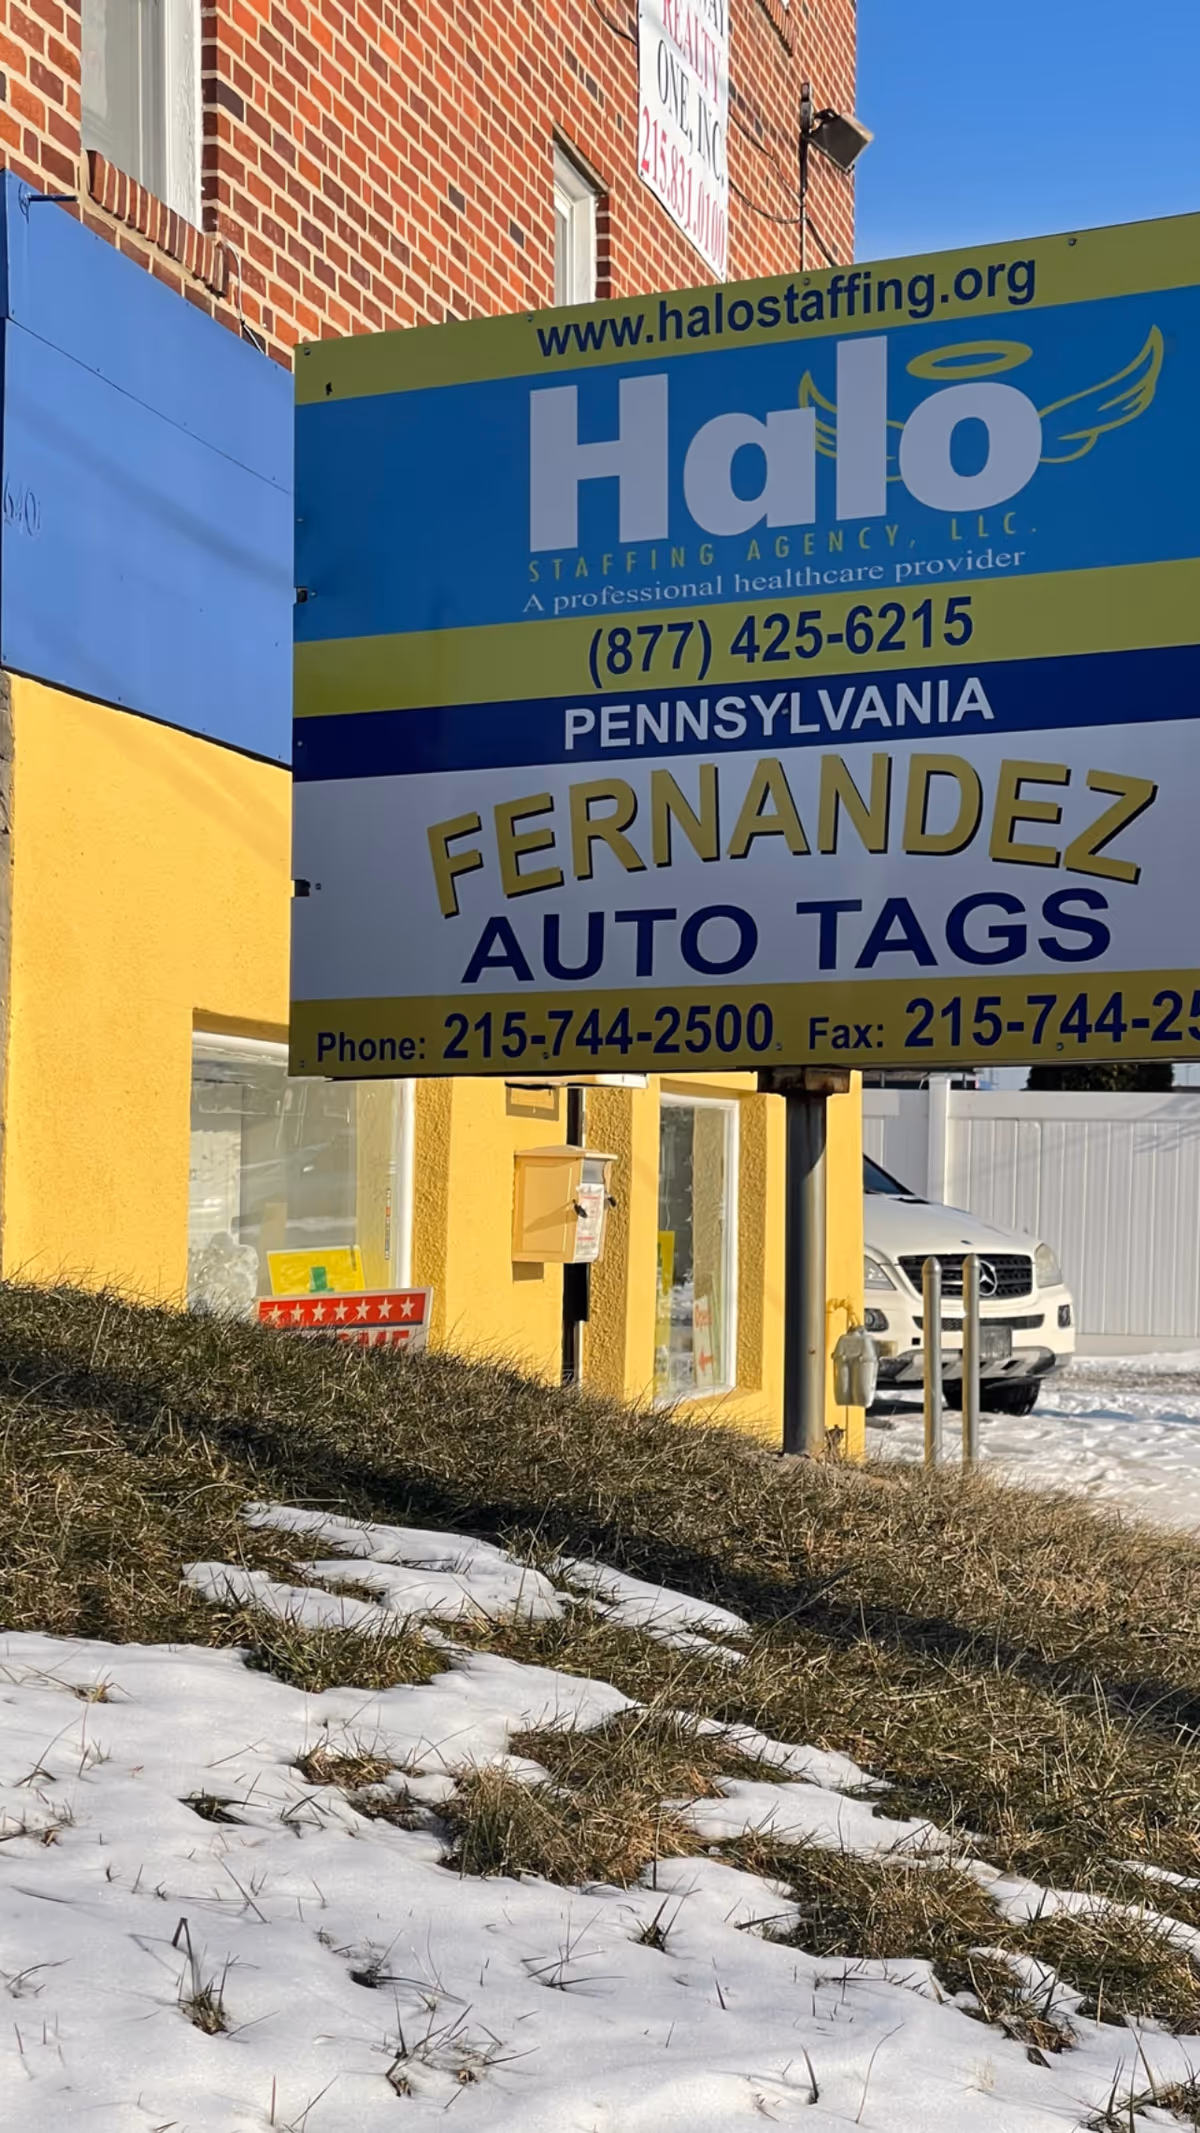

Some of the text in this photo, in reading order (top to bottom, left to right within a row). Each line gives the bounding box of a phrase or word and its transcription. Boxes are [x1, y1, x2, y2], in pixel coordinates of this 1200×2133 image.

[641, 105, 726, 270] 215.831.0100
[537, 258, 1036, 357] www.halostaffing.org
[530, 335, 1043, 553] Halo
[522, 548, 1026, 614] A professional healthcare provider
[528, 511, 1037, 583] STAFFING AGENCY, LLC.
[588, 596, 974, 689] (877) 425-6215
[564, 676, 996, 750] PENNSYLVANIA
[427, 752, 1159, 918] FERNANDEZ
[460, 888, 1112, 984] AUTO TAGS
[317, 1031, 427, 1062] Phone:
[443, 1002, 775, 1059] 215-744-2500
[808, 1016, 885, 1050] Fax:
